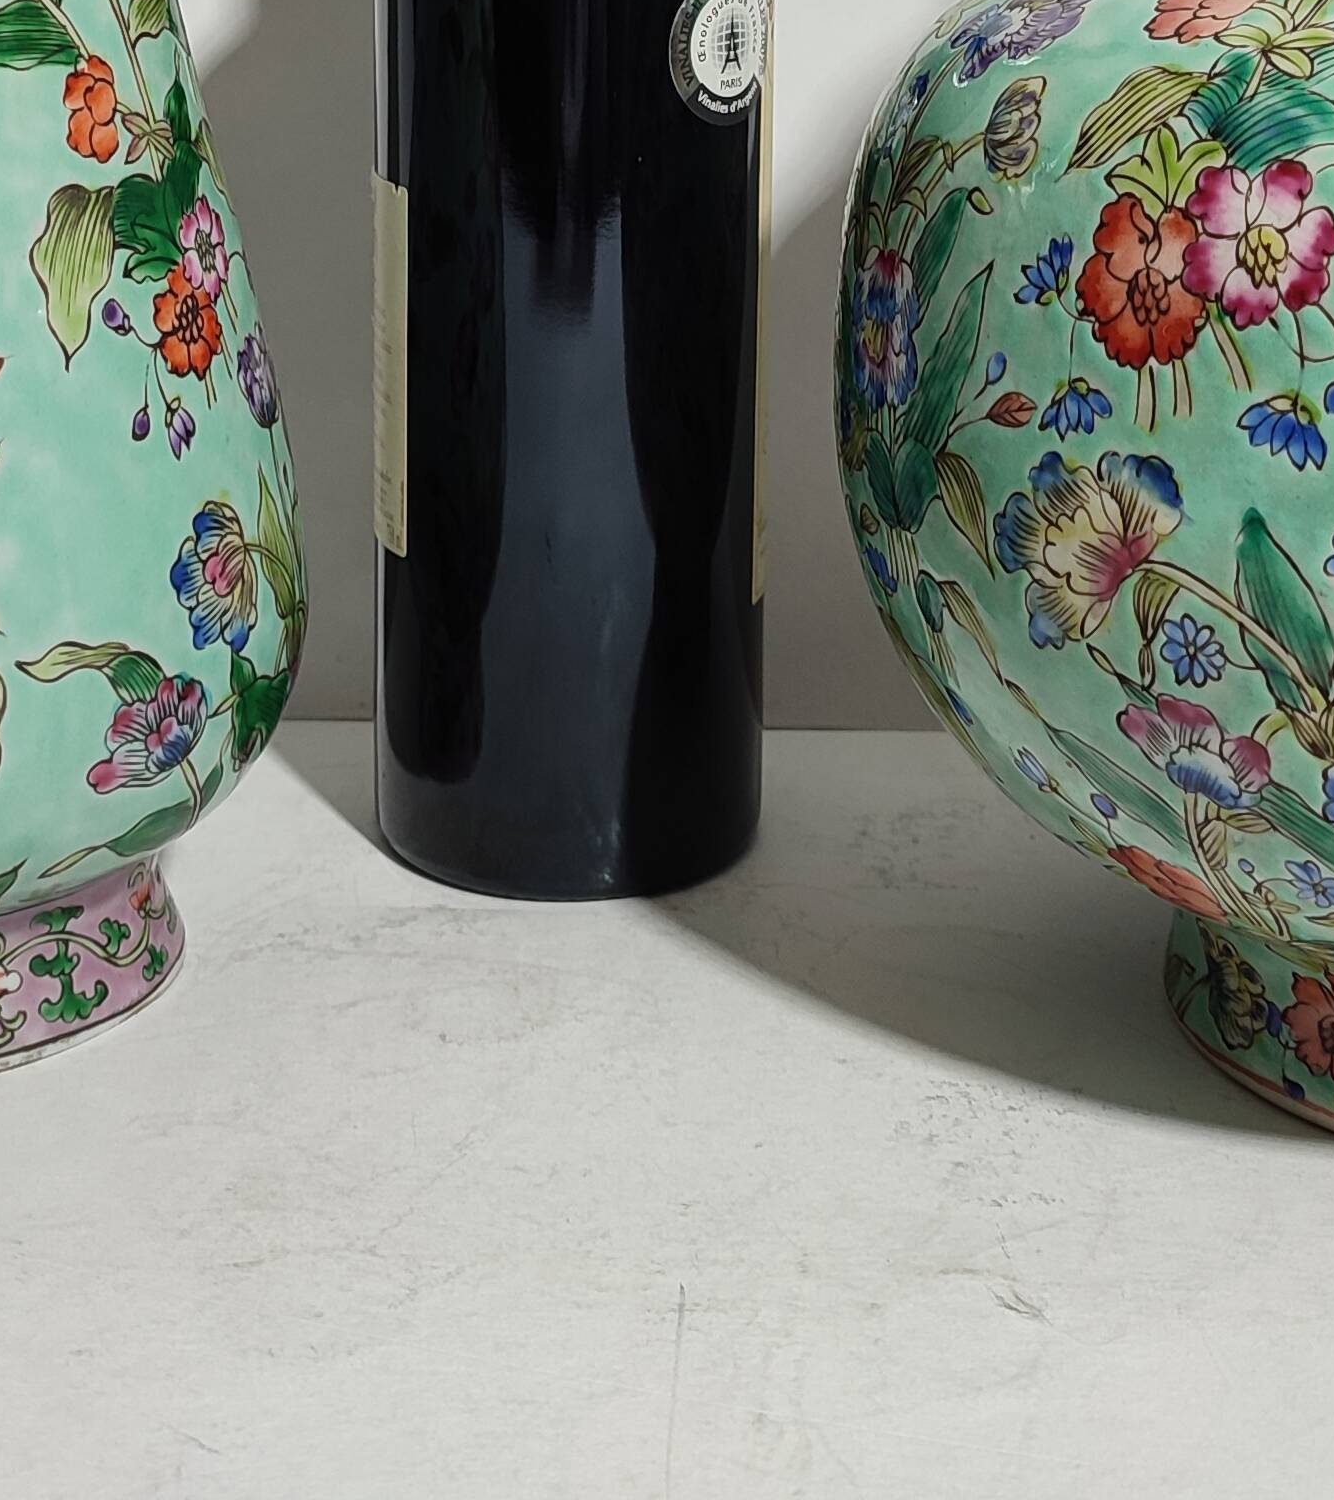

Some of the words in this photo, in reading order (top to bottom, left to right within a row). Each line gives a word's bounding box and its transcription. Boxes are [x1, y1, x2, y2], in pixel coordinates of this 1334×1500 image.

[679, 12, 695, 87] VINALIES
[720, 77, 743, 90] PARIS
[698, 89, 728, 113] Vinalies
